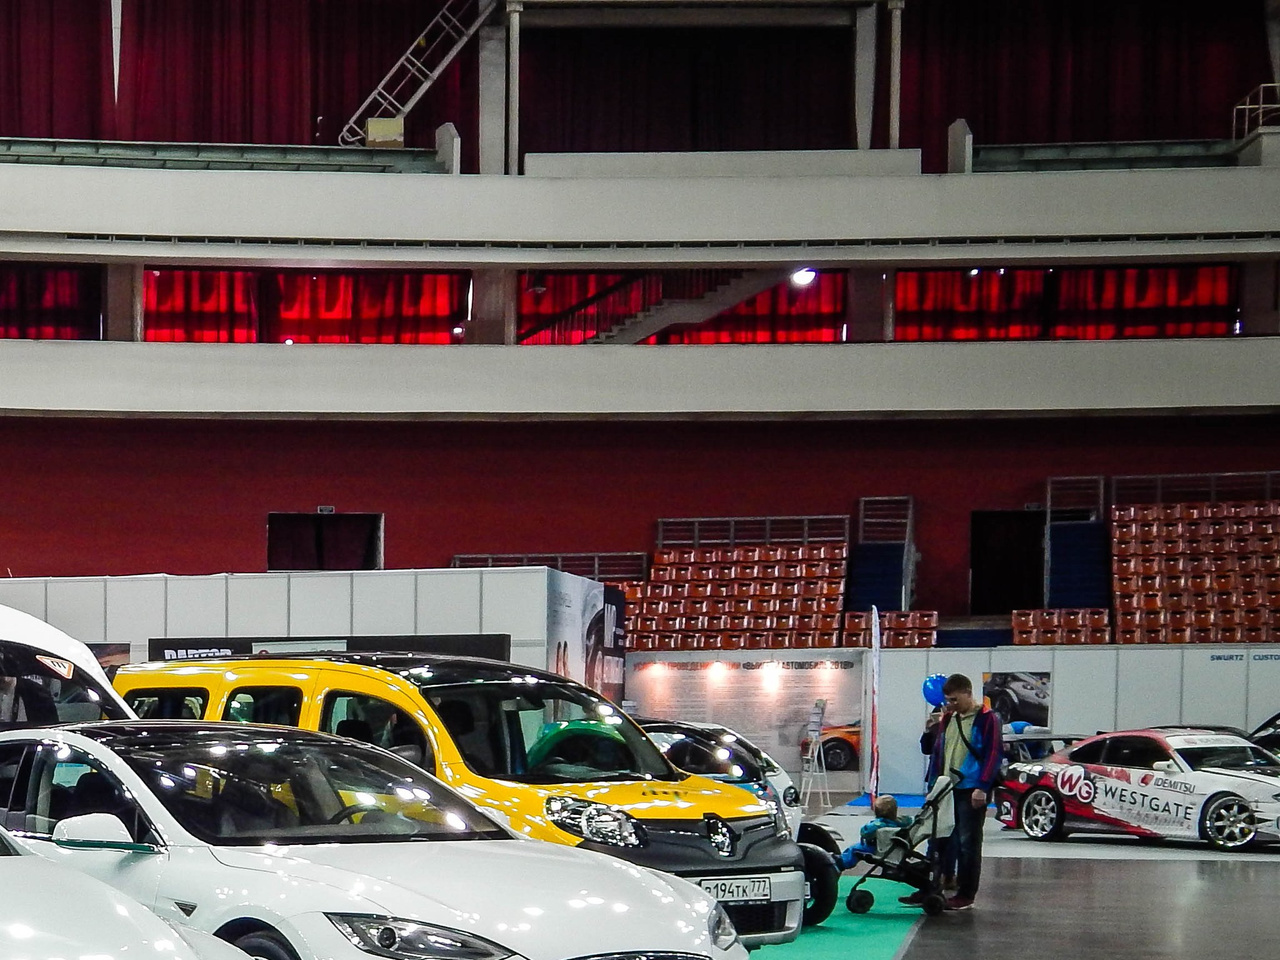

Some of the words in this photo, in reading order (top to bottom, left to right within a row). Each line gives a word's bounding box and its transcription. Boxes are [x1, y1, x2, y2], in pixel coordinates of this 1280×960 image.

[1154, 777, 1196, 793] IDEMITSU
[1103, 783, 1194, 821] WESTGATE
[750, 880, 767, 893] 777
